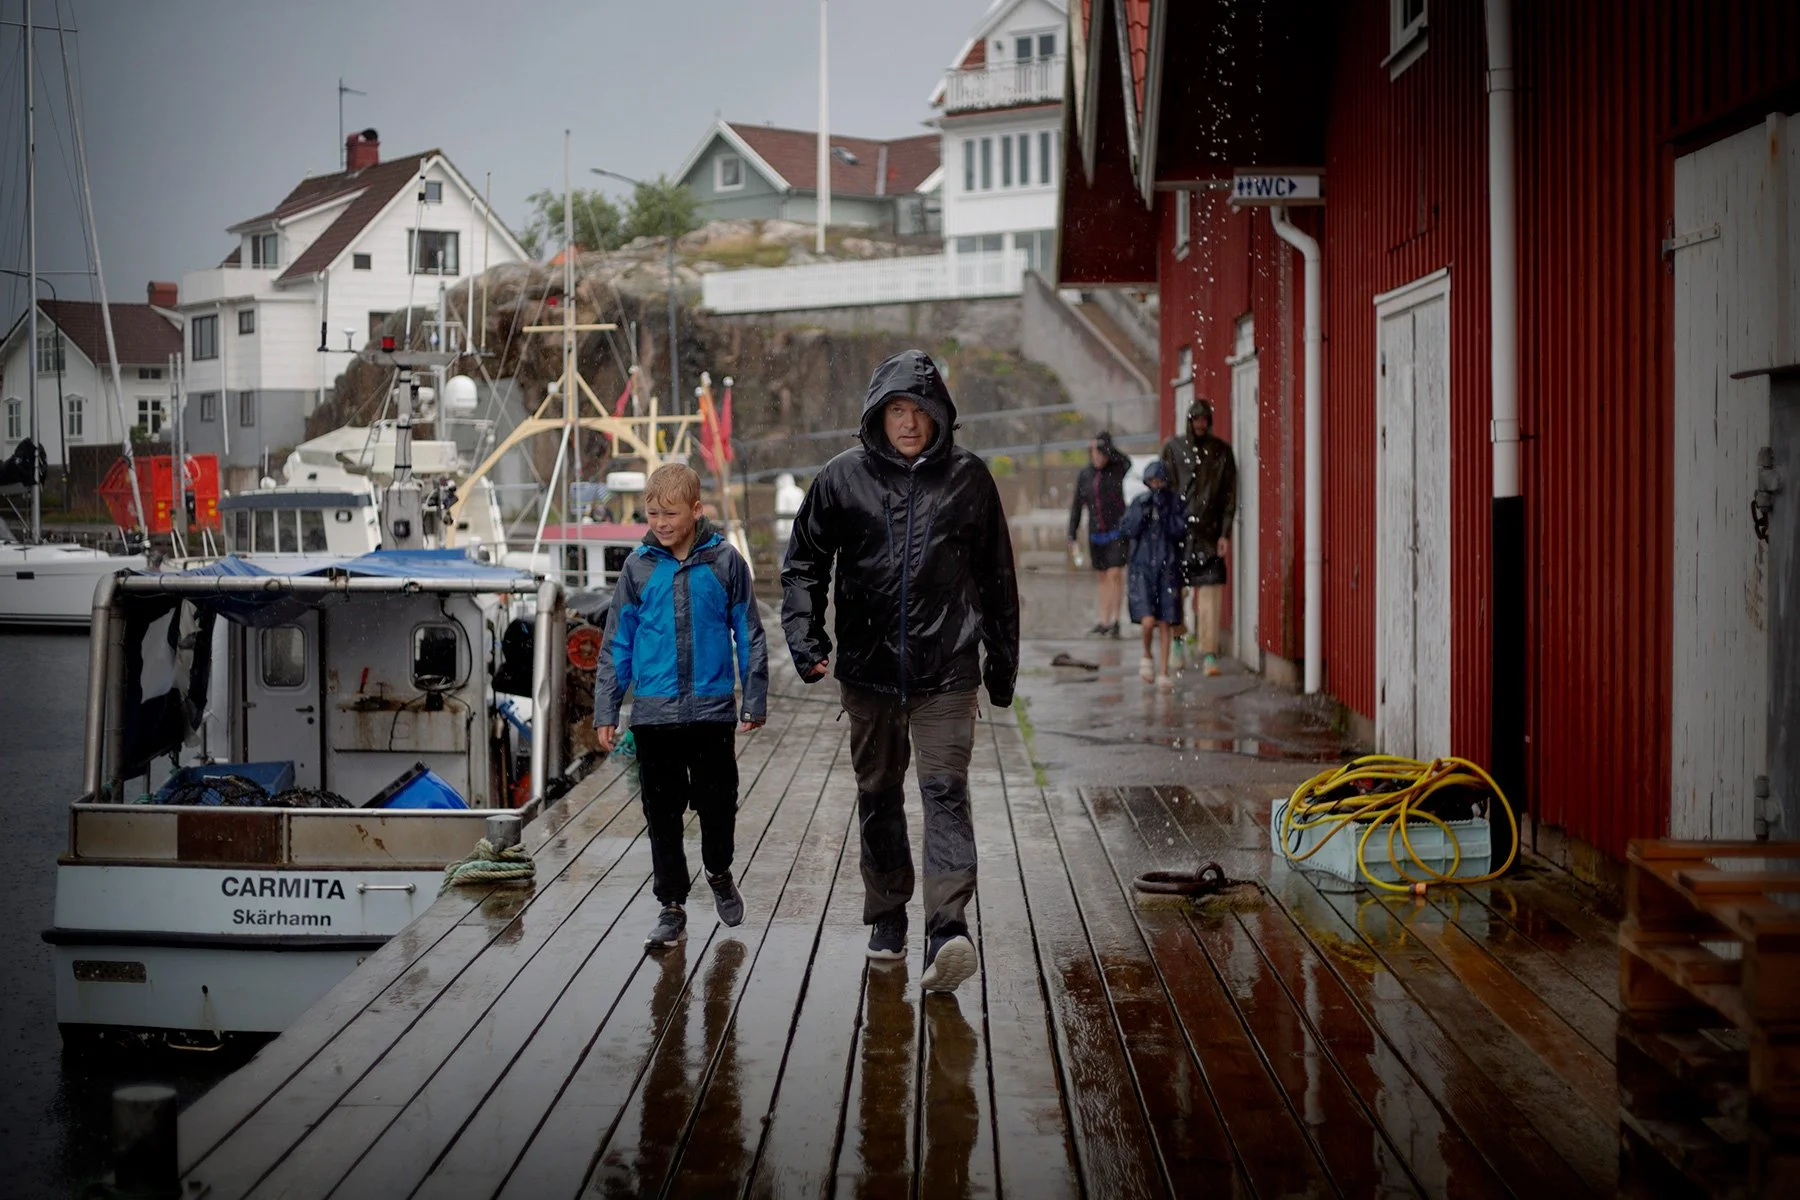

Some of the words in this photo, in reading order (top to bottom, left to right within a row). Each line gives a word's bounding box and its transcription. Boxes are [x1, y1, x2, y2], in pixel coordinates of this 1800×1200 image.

[1256, 177, 1286, 196] WC
[221, 876, 346, 900] CARMITA
[232, 909, 332, 927] Skärhamn
